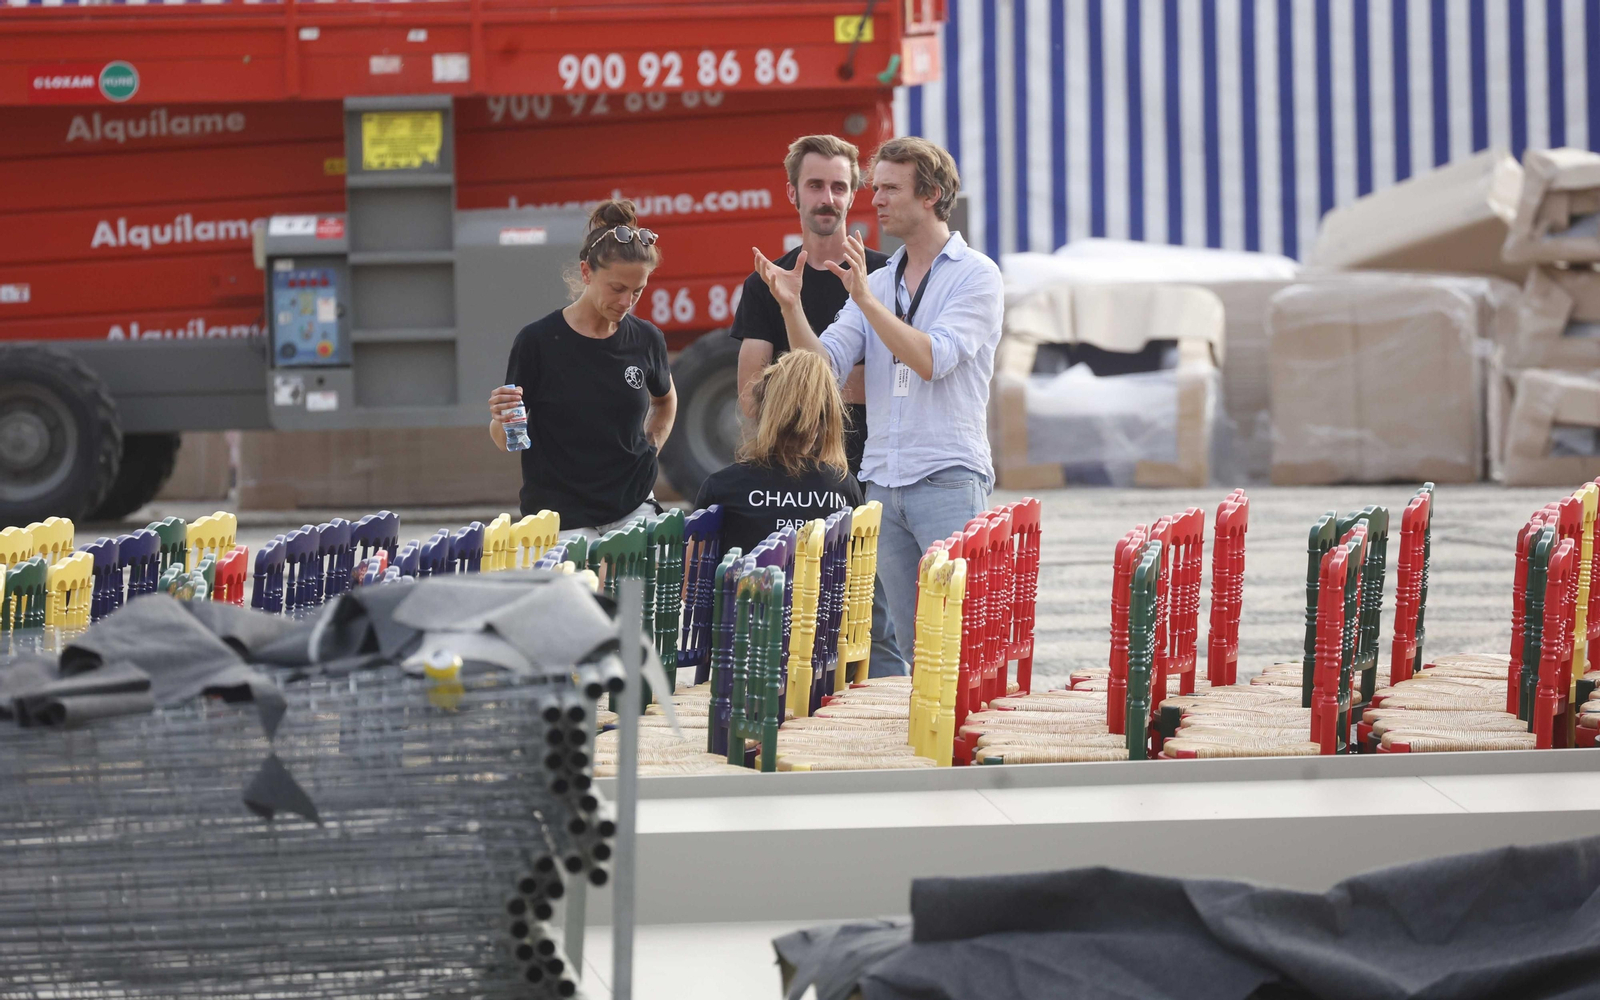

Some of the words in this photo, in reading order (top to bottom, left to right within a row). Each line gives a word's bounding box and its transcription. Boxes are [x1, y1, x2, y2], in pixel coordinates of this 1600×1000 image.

[557, 53, 626, 90] 900
[637, 51, 684, 88] 92
[697, 50, 742, 87] 86
[754, 48, 800, 85] 86
[487, 94, 552, 123] 900
[66, 108, 246, 143] Alquílame
[651, 288, 696, 324] 86
[748, 489, 847, 510] CHAUVIN
[776, 518, 808, 530] PAR
